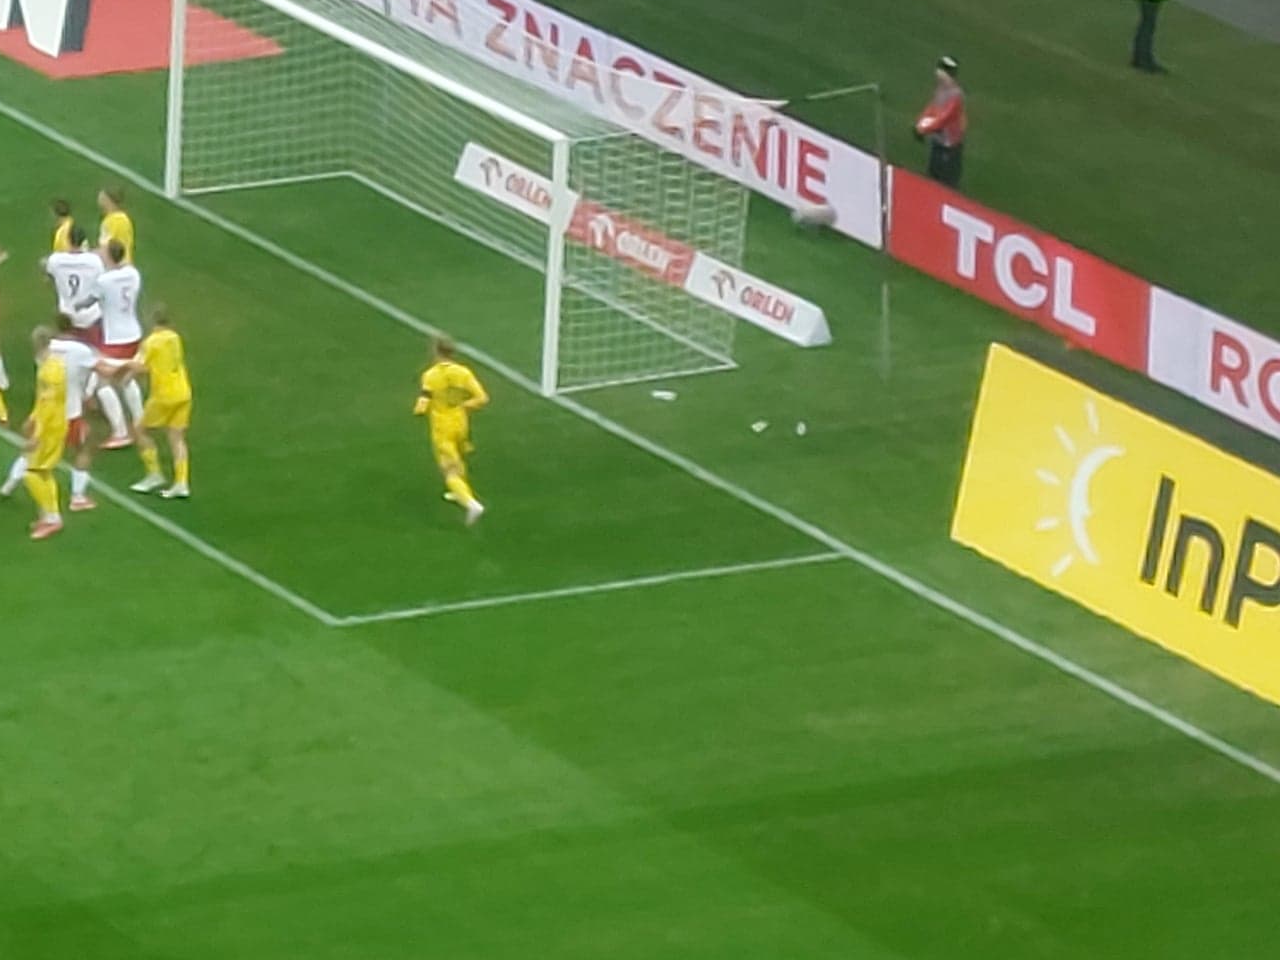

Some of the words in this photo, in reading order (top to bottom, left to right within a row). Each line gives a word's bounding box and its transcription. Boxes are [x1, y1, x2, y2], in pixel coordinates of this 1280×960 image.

[68, 273, 81, 297] 9
[941, 203, 1096, 337] TCL
[740, 284, 795, 326] ORLEN
